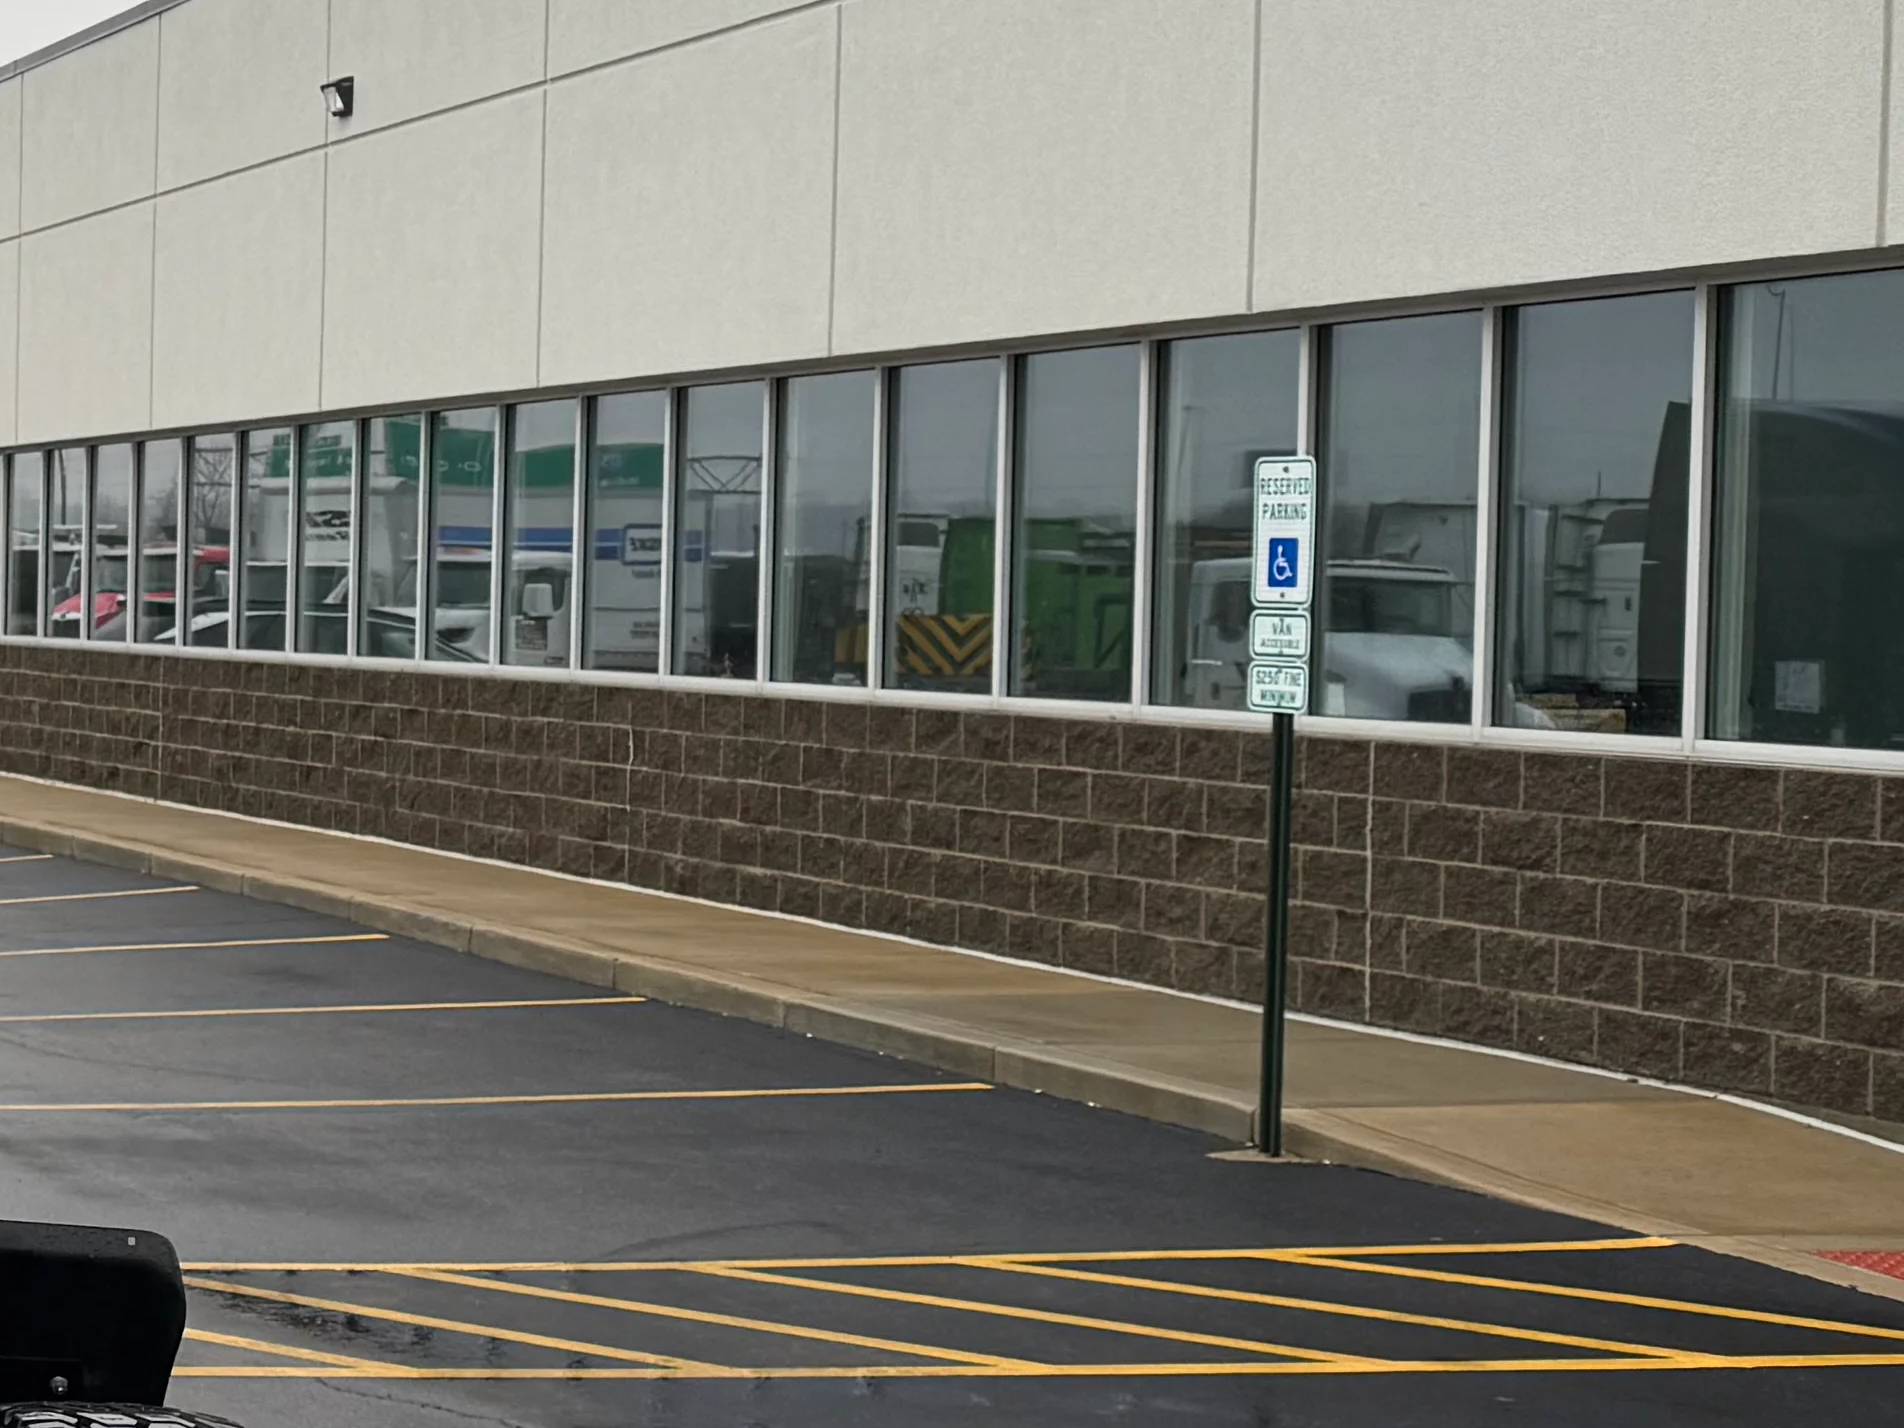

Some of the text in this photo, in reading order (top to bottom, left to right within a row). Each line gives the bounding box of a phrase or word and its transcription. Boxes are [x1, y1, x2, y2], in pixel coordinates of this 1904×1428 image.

[1261, 477, 1311, 495] RESERVED
[1263, 503, 1307, 520] PARKING
[1272, 622, 1292, 636] VAN
[1284, 671, 1302, 686] FINE
